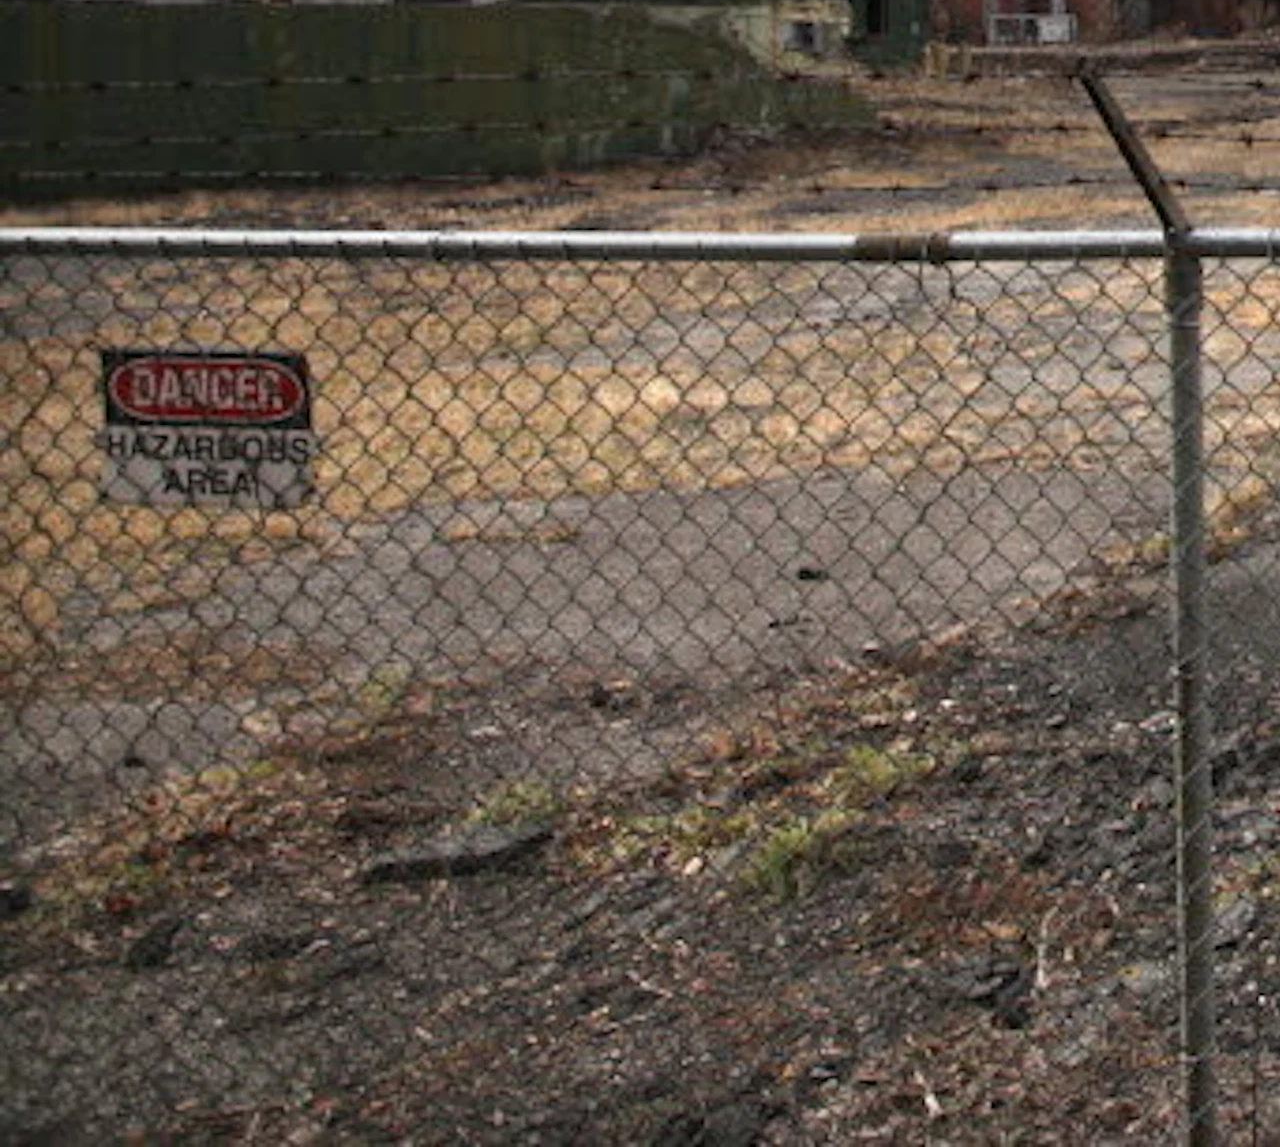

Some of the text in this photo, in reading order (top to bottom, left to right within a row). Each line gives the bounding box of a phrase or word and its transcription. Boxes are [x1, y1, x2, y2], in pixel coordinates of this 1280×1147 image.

[132, 367, 284, 410] DANGER
[108, 433, 310, 463] HAZARDOUS
[164, 468, 254, 495] AREA
